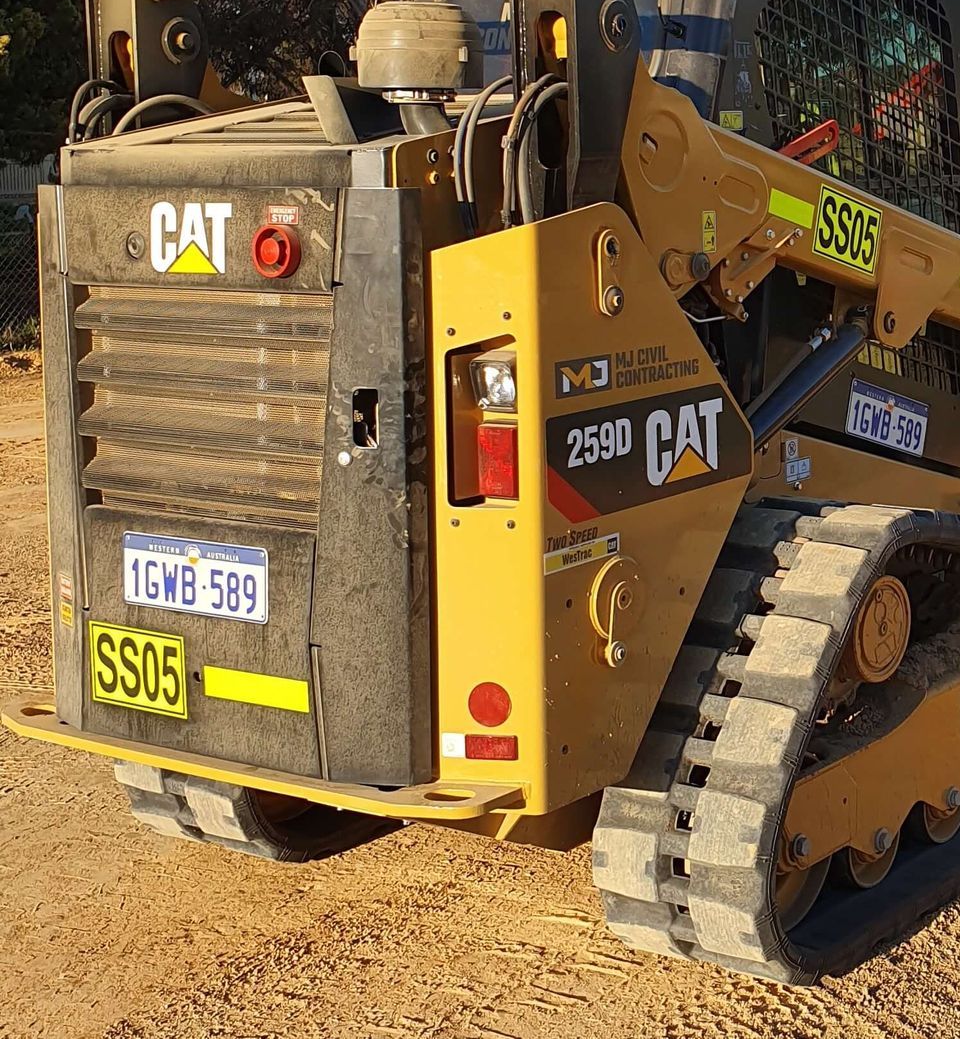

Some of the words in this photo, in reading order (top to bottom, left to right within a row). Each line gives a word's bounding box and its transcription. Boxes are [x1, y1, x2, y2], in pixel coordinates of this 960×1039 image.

[271, 214, 295, 223] STOP
[818, 195, 878, 266] SS05
[150, 201, 233, 274] CAT
[615, 351, 633, 369] MJ
[637, 345, 668, 364] CIVIL
[616, 358, 699, 388] CONTRACTING
[560, 359, 608, 393] MJ
[567, 418, 632, 469] 259D
[645, 397, 723, 487] CAT
[148, 544, 180, 554] WESTERN
[206, 551, 239, 562] AUSTRALIA
[562, 548, 593, 566] WesTrac
[96, 632, 181, 706] SS05
